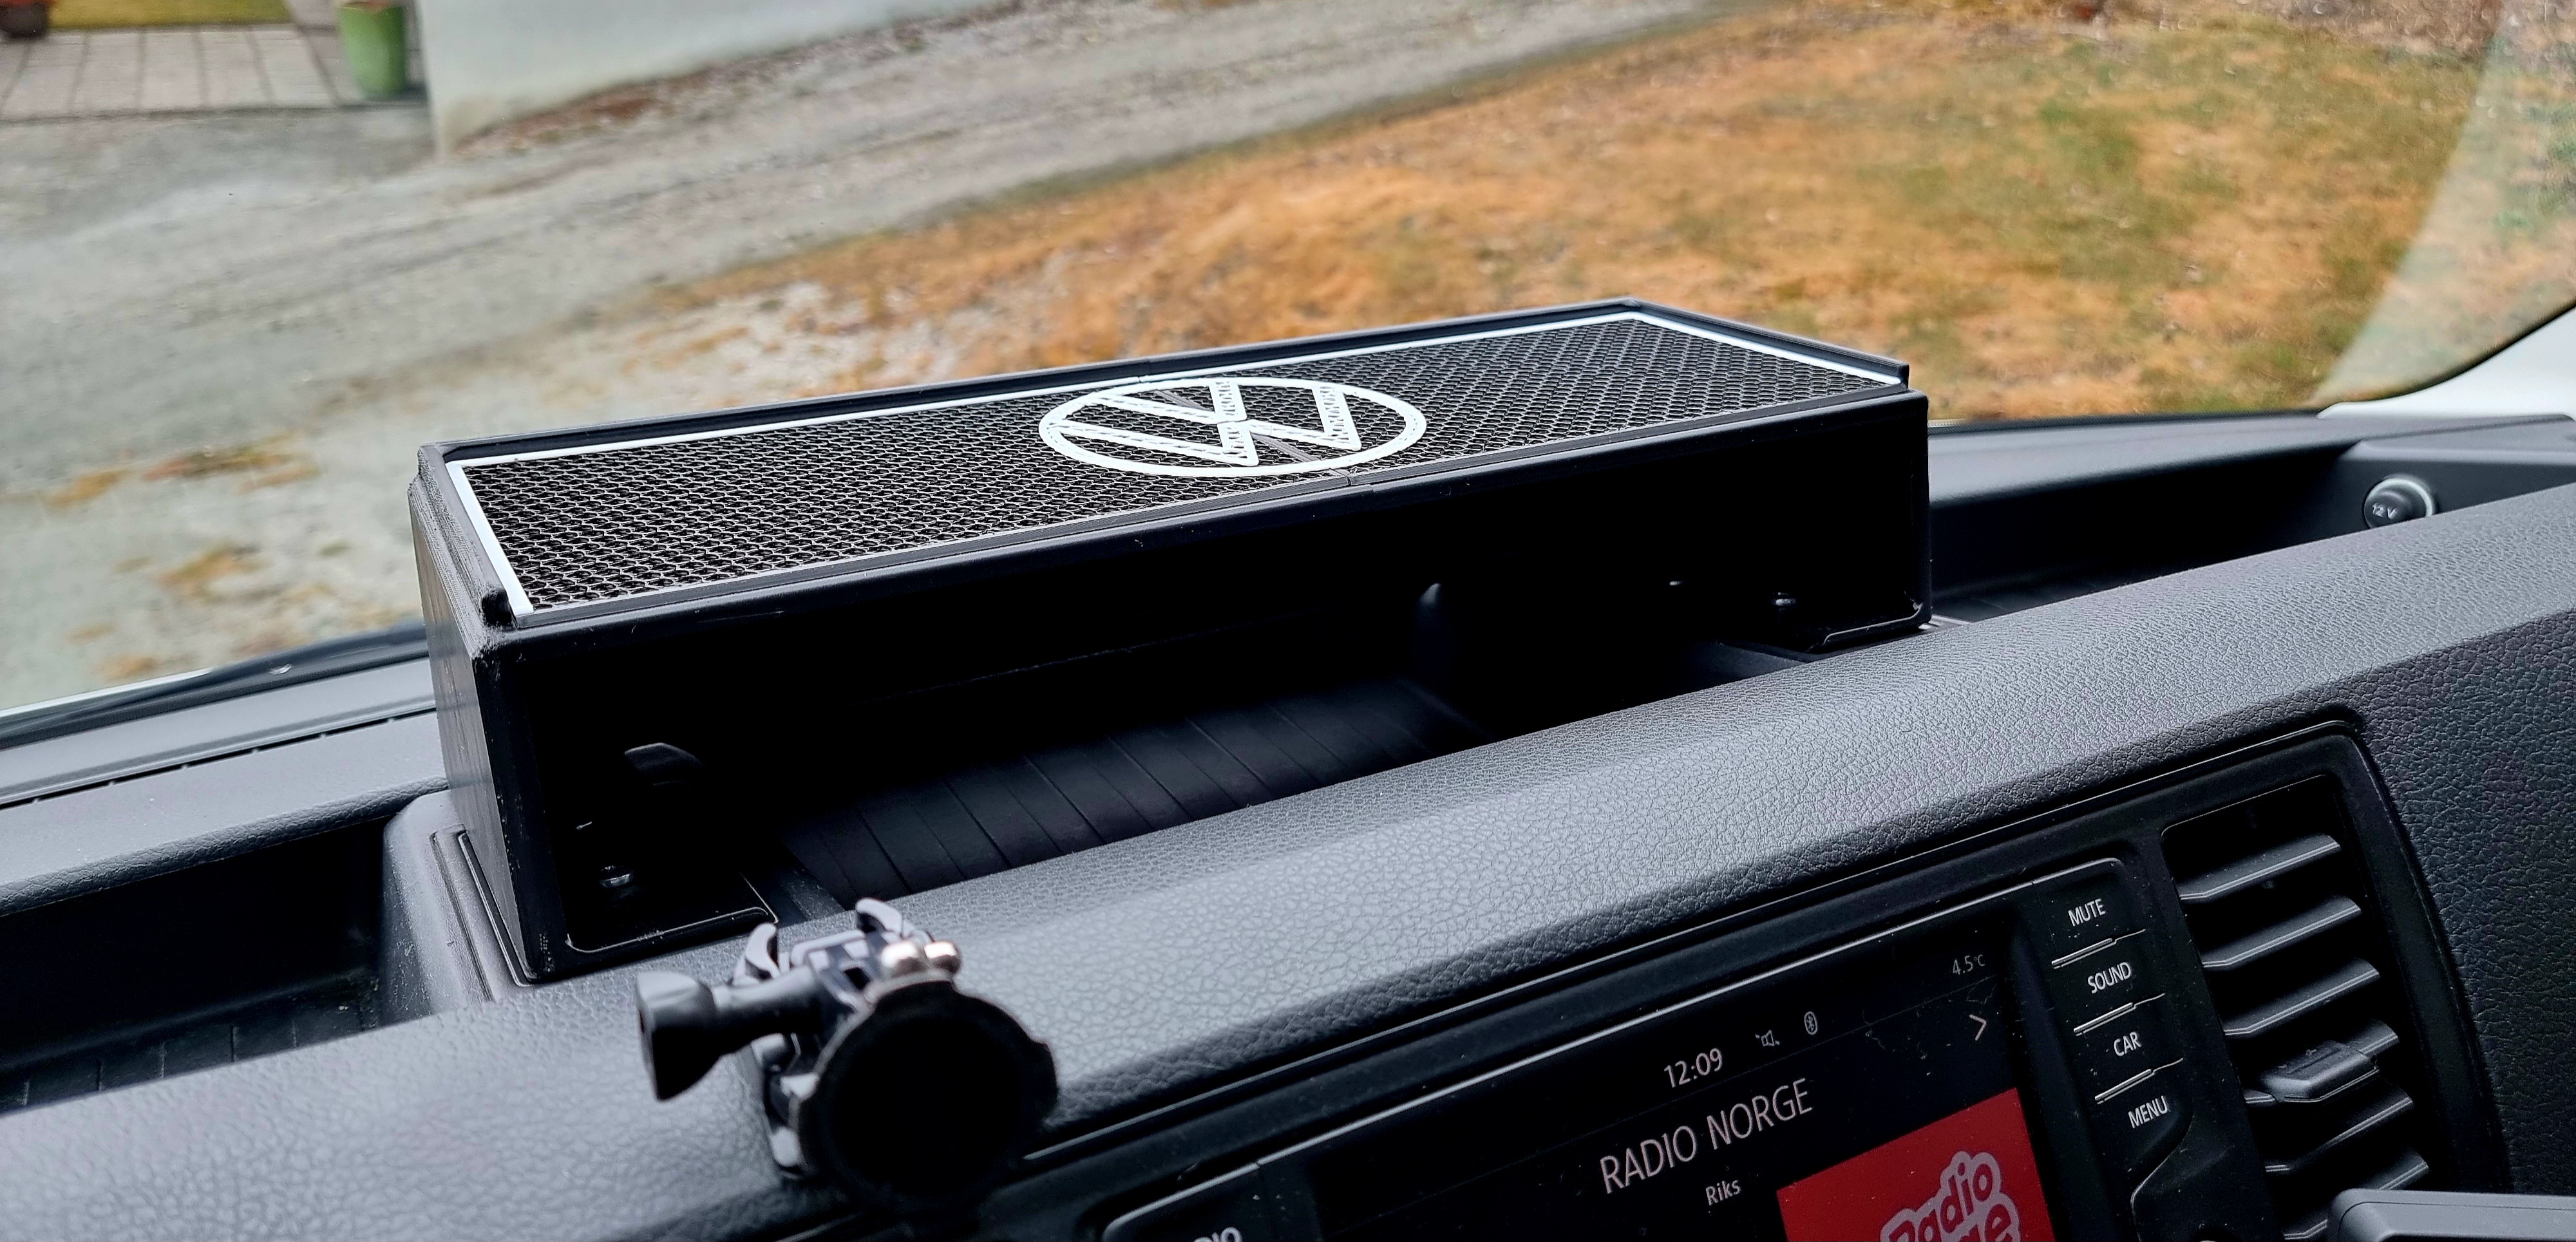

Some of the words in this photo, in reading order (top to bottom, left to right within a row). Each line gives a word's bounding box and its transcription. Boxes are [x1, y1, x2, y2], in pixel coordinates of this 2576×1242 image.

[2372, 503, 2384, 518] 12
[2387, 506, 2397, 520] V
[2068, 898, 2106, 927] MUTE
[2087, 962, 2132, 994] SOUND
[2114, 1031, 2141, 1057] CAR
[1663, 1048, 1723, 1088] 12:09
[2128, 1095, 2169, 1129] MENU
[1600, 1125, 1697, 1194] RADIO
[1707, 1078, 1812, 1150] NORGE
[1705, 1180, 1741, 1206] Riks
